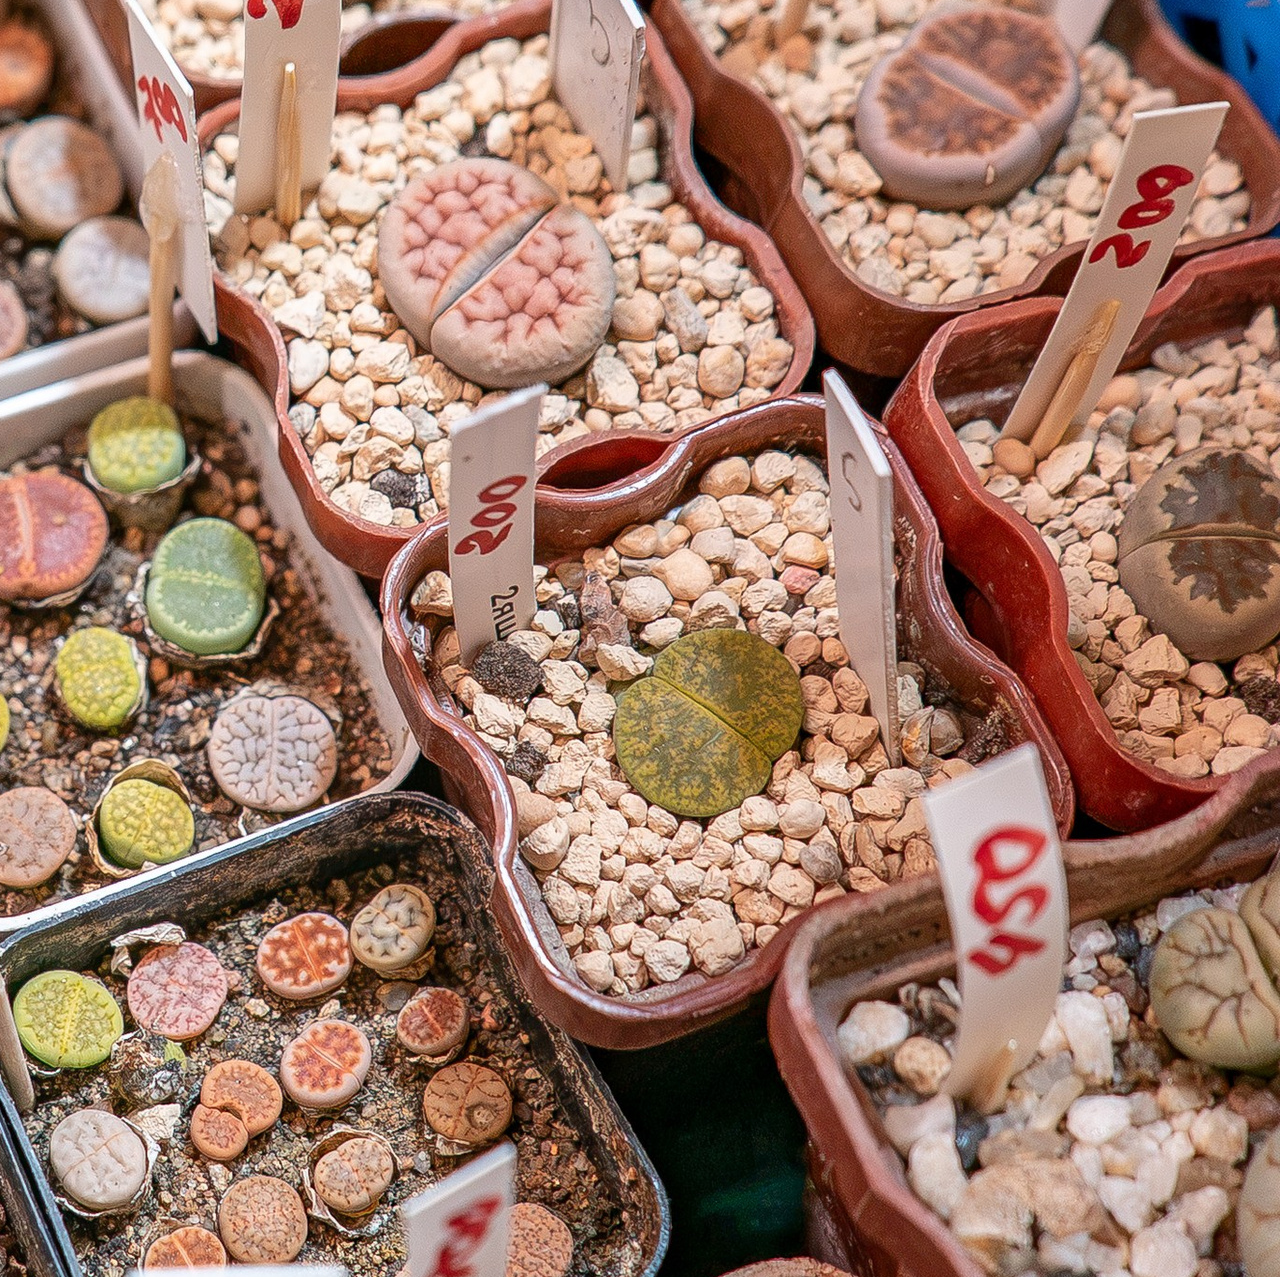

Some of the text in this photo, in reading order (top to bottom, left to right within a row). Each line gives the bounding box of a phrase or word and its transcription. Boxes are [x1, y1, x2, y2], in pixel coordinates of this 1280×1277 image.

[137, 76, 187, 141] 700
[1090, 165, 1194, 268] 200
[455, 475, 527, 555] 200
[970, 827, 1048, 975] 450
